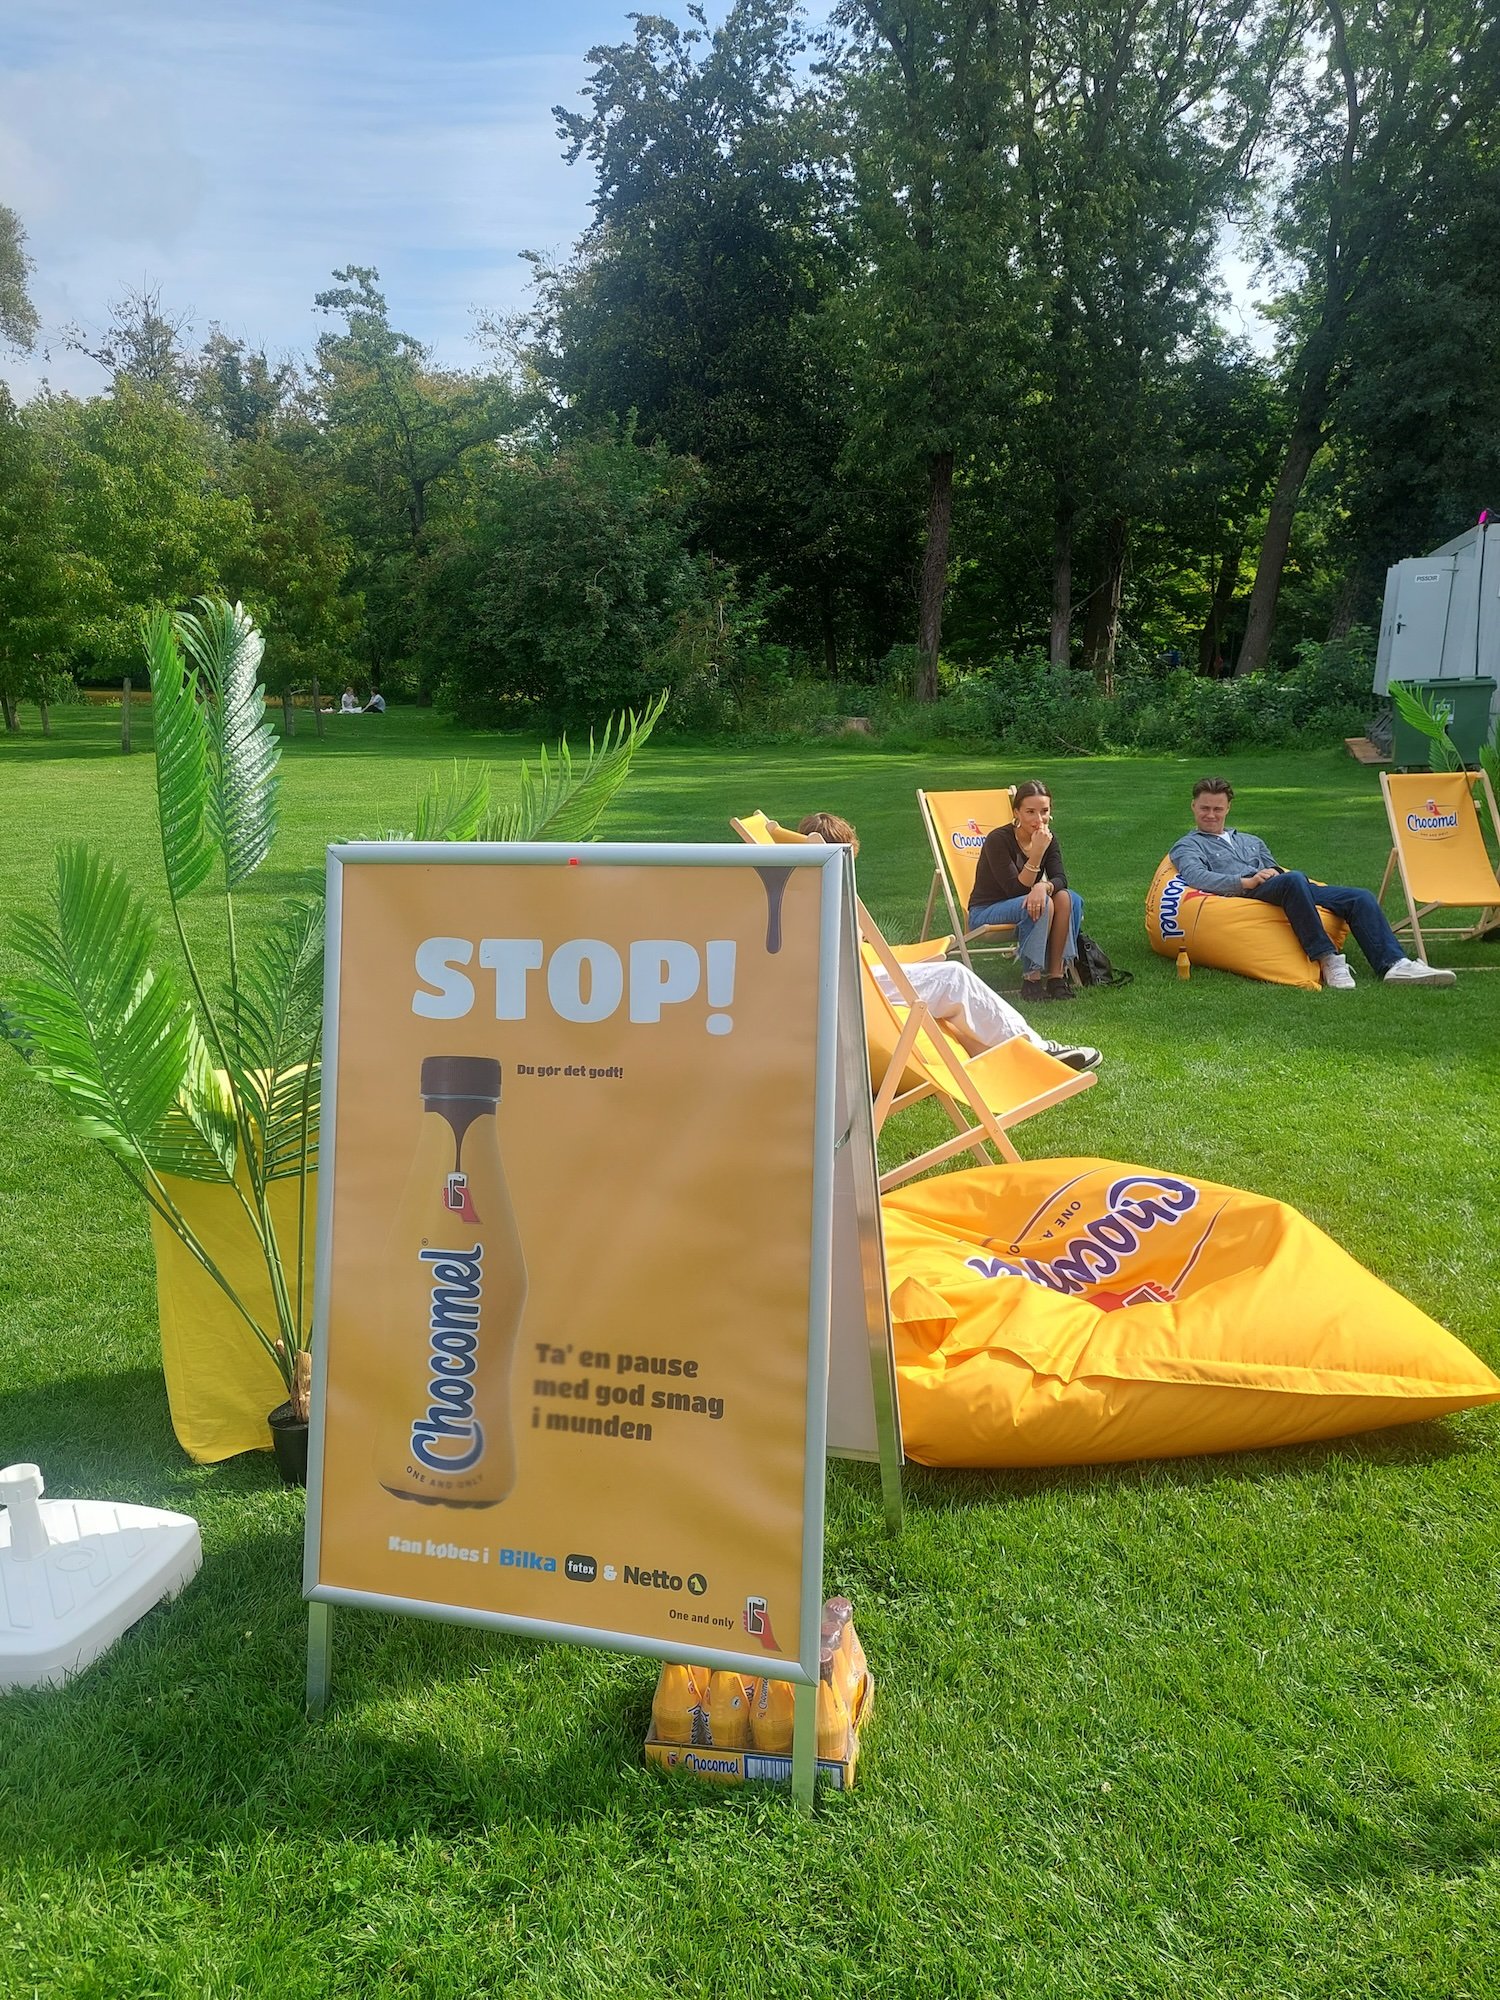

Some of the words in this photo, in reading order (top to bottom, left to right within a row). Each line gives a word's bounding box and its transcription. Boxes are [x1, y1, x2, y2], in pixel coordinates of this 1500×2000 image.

[1407, 811, 1458, 832] Chocomel
[411, 937, 737, 1036] STOP!
[517, 1064, 535, 1075] Du
[537, 1066, 561, 1077] gør
[564, 1065, 586, 1076] det
[589, 1066, 624, 1079] godt!
[411, 1243, 485, 1474] Chocomel
[535, 1343, 573, 1365] Ta'
[579, 1350, 611, 1369] en
[616, 1353, 698, 1378] pause
[533, 1379, 589, 1400] med
[595, 1384, 645, 1406] god
[651, 1390, 724, 1419] smag
[531, 1407, 540, 1428] i
[546, 1413, 653, 1441] munden
[406, 1465, 426, 1483] ONE
[388, 1536, 422, 1554] Kan
[426, 1540, 480, 1562] købes
[483, 1547, 489, 1564] i
[500, 1548, 557, 1572] Bilka
[603, 1565, 617, 1581] &
[623, 1566, 683, 1591] Netto
[669, 1609, 689, 1621] One
[691, 1614, 710, 1625] and
[712, 1617, 735, 1630] only
[685, 1754, 740, 1775] Chocomel
